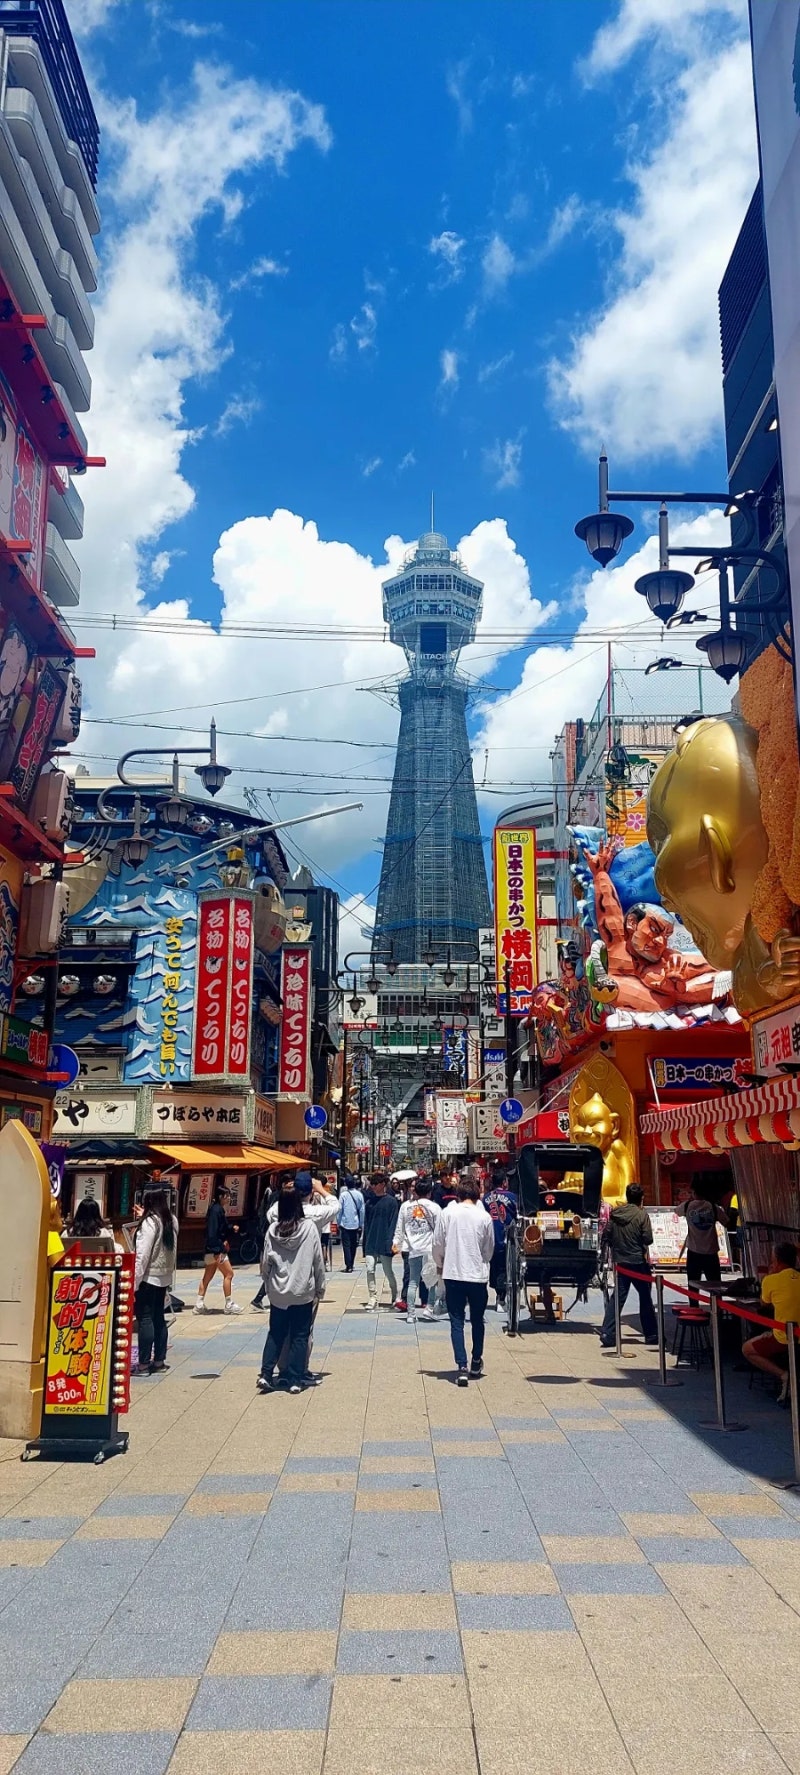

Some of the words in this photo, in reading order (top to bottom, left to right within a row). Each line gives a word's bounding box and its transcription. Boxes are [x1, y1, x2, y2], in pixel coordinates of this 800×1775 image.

[507, 845, 525, 927] 日本一の串かつ
[206, 908, 224, 949] 名物
[234, 908, 250, 949] 名物
[502, 929, 533, 991] 横綱
[159, 917, 184, 1076] 安うて何んでも旨い
[201, 979, 222, 1066] てっちり
[231, 979, 247, 1065] てっちり
[284, 972, 305, 1089] 珍味てっちり
[666, 1064, 733, 1082] 日本一の串かつ
[157, 1106, 241, 1124] づぼらや本店
[55, 1275, 93, 1377] 射的体験
[48, 1377, 66, 1392] 8発
[57, 1389, 82, 1403] 500円
